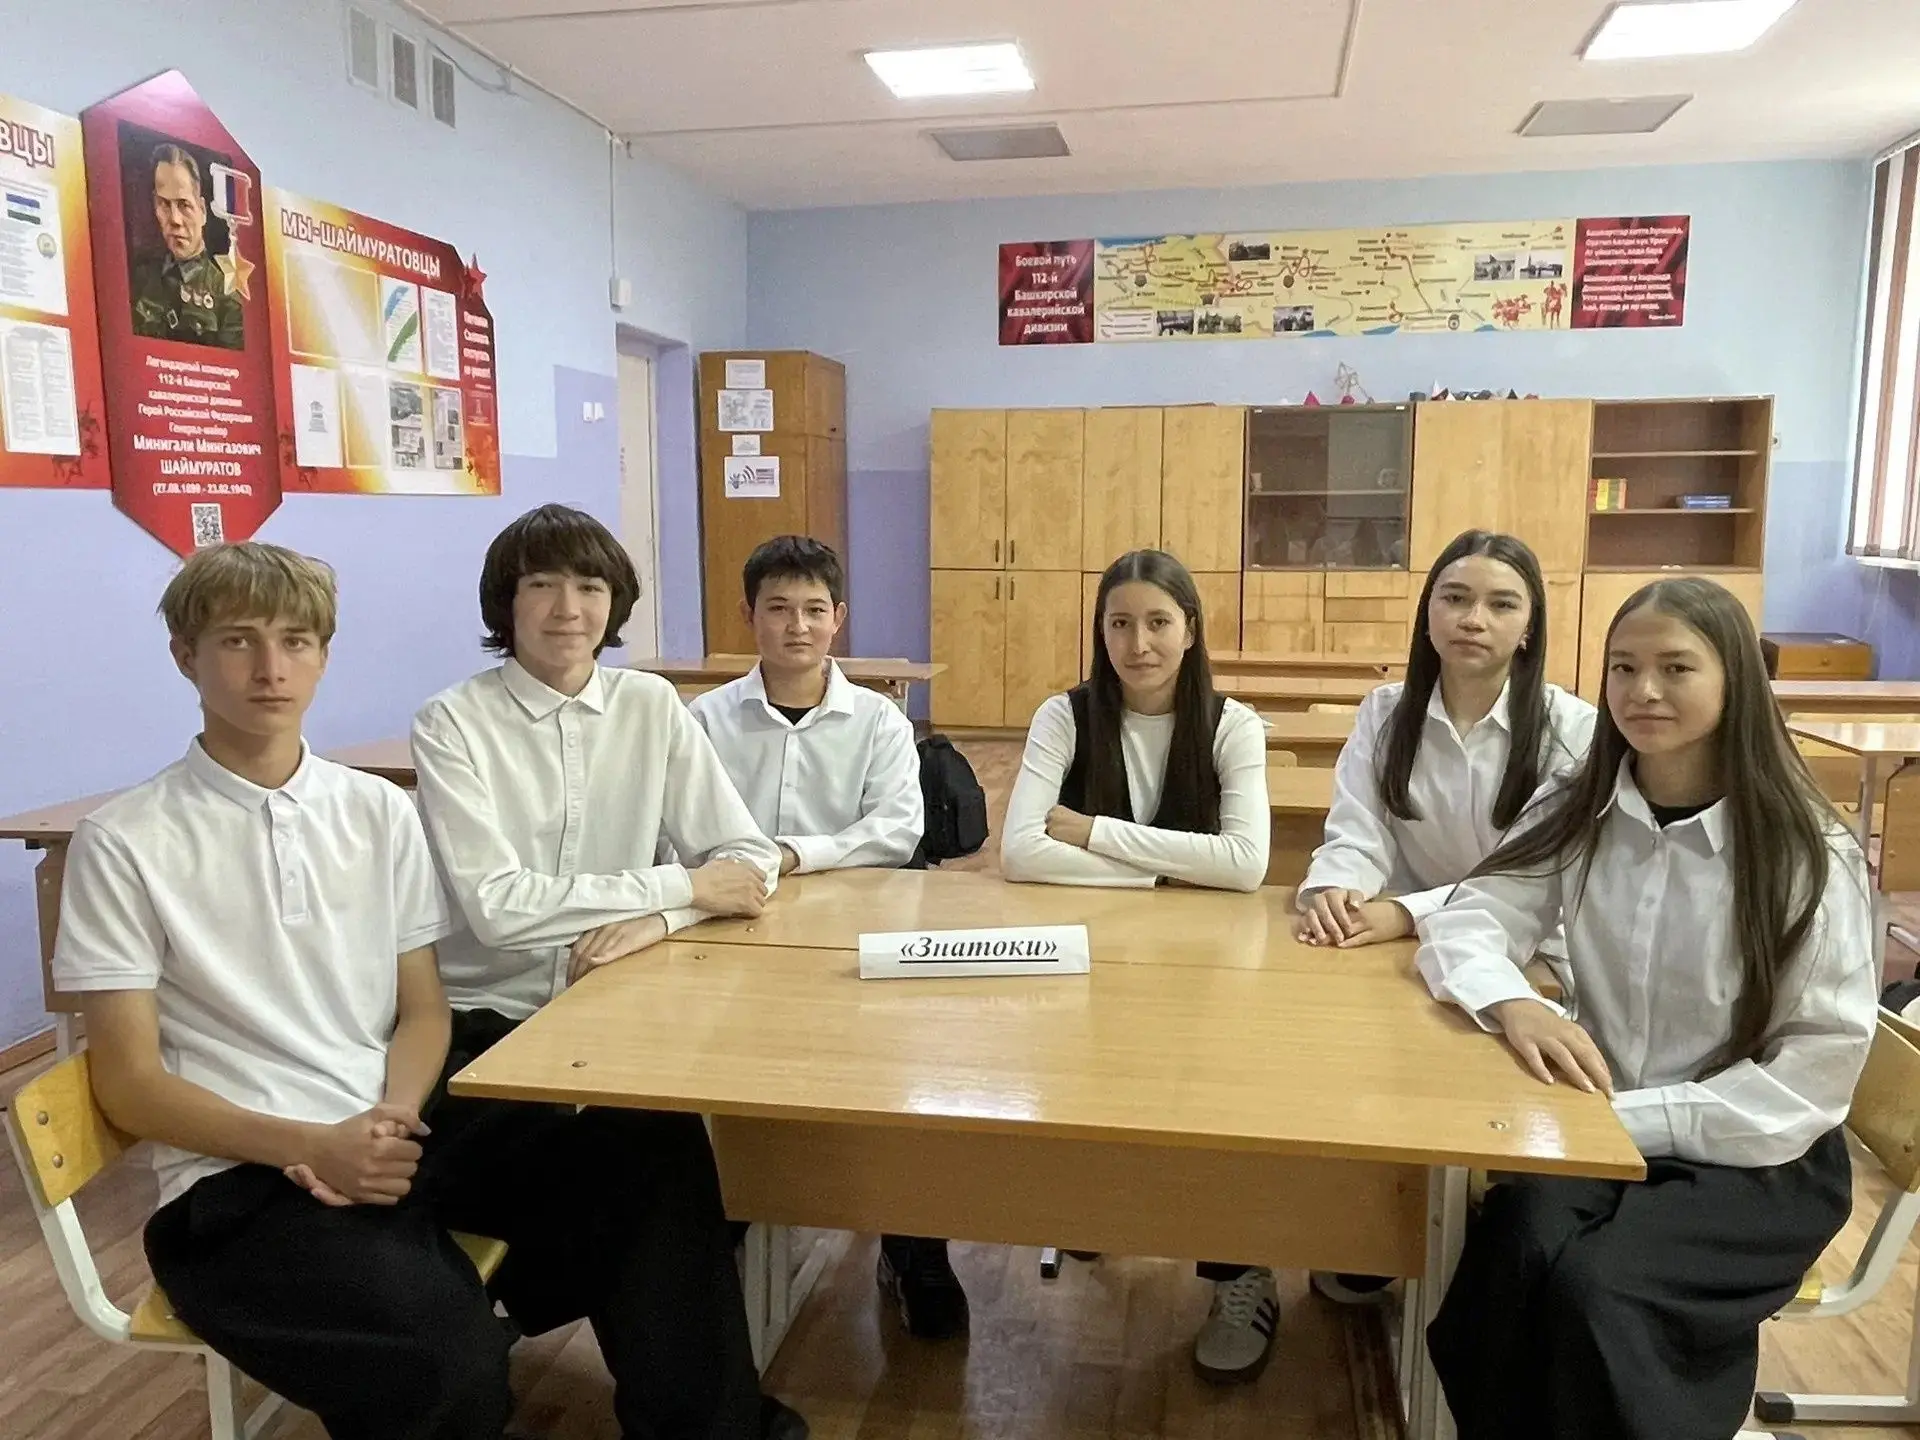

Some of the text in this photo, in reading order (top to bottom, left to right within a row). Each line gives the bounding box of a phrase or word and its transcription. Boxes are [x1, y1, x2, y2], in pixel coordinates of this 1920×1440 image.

[1015, 254, 1077, 268] Боевой путь
[1032, 271, 1058, 284] 112-й
[1014, 287, 1077, 303] Башкирской
[1007, 302, 1085, 319] кавалерийской
[1023, 322, 1068, 335] дивизии
[133, 433, 261, 455] Минигали Мингазович
[160, 457, 242, 477] ШАЙМУРАТОВ
[900, 936, 1057, 958] «Знатоки»
